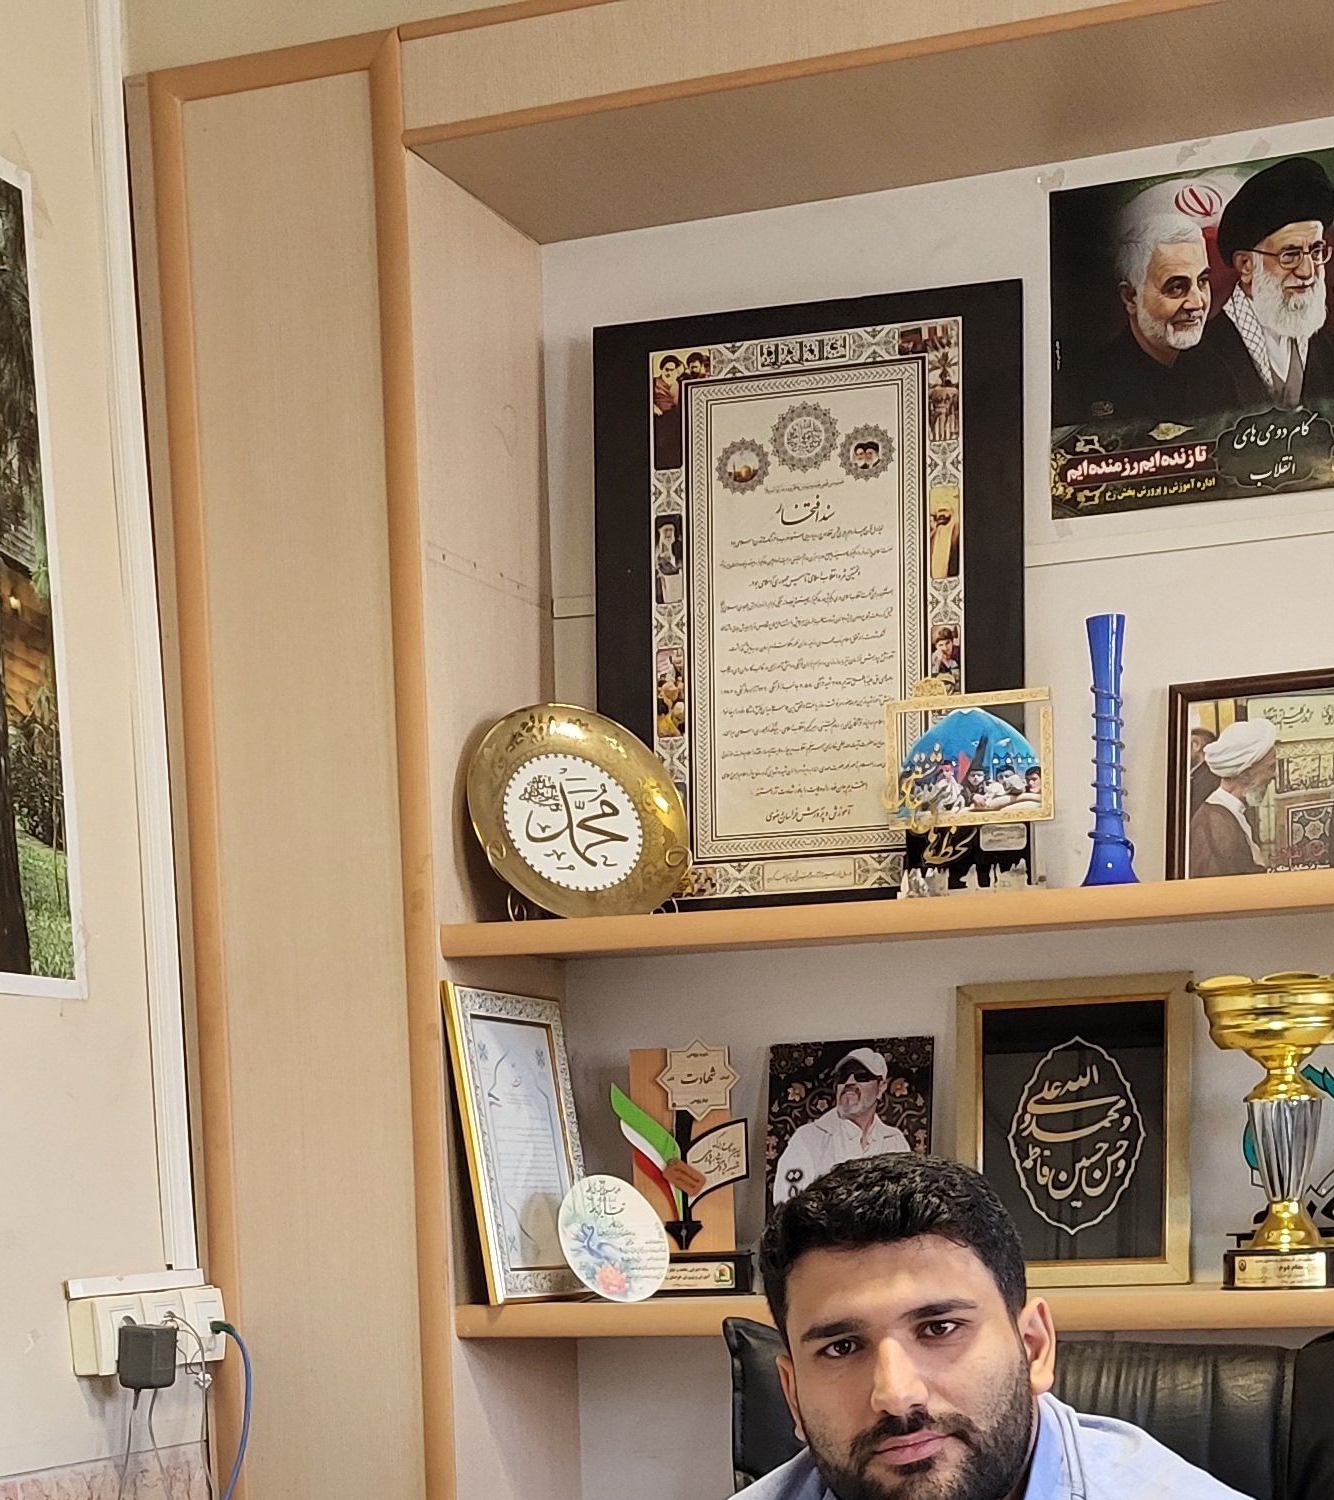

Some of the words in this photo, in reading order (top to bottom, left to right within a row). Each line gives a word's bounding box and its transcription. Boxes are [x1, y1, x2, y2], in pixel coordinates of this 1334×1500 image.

[1139, 450, 1160, 474] ایم
[1161, 447, 1194, 468] زنده
[1194, 445, 1208, 462] تا
[1067, 459, 1088, 482] ایم
[1088, 457, 1138, 477] رزمنده
[1249, 455, 1296, 487] انقلاب
[1118, 487, 1136, 501] بخش
[1137, 485, 1162, 498] پرورش
[1169, 478, 1195, 494] آموزش
[1196, 477, 1216, 491] اداره
[774, 493, 821, 526] افتخار
[797, 804, 825, 823] پرورش
[829, 804, 855, 821] آموزش
[680, 1065, 716, 1085] شهادت
[1058, 1063, 1100, 1097] الله
[1026, 1079, 1121, 1116] علی
[1020, 1097, 1127, 1144] محمد
